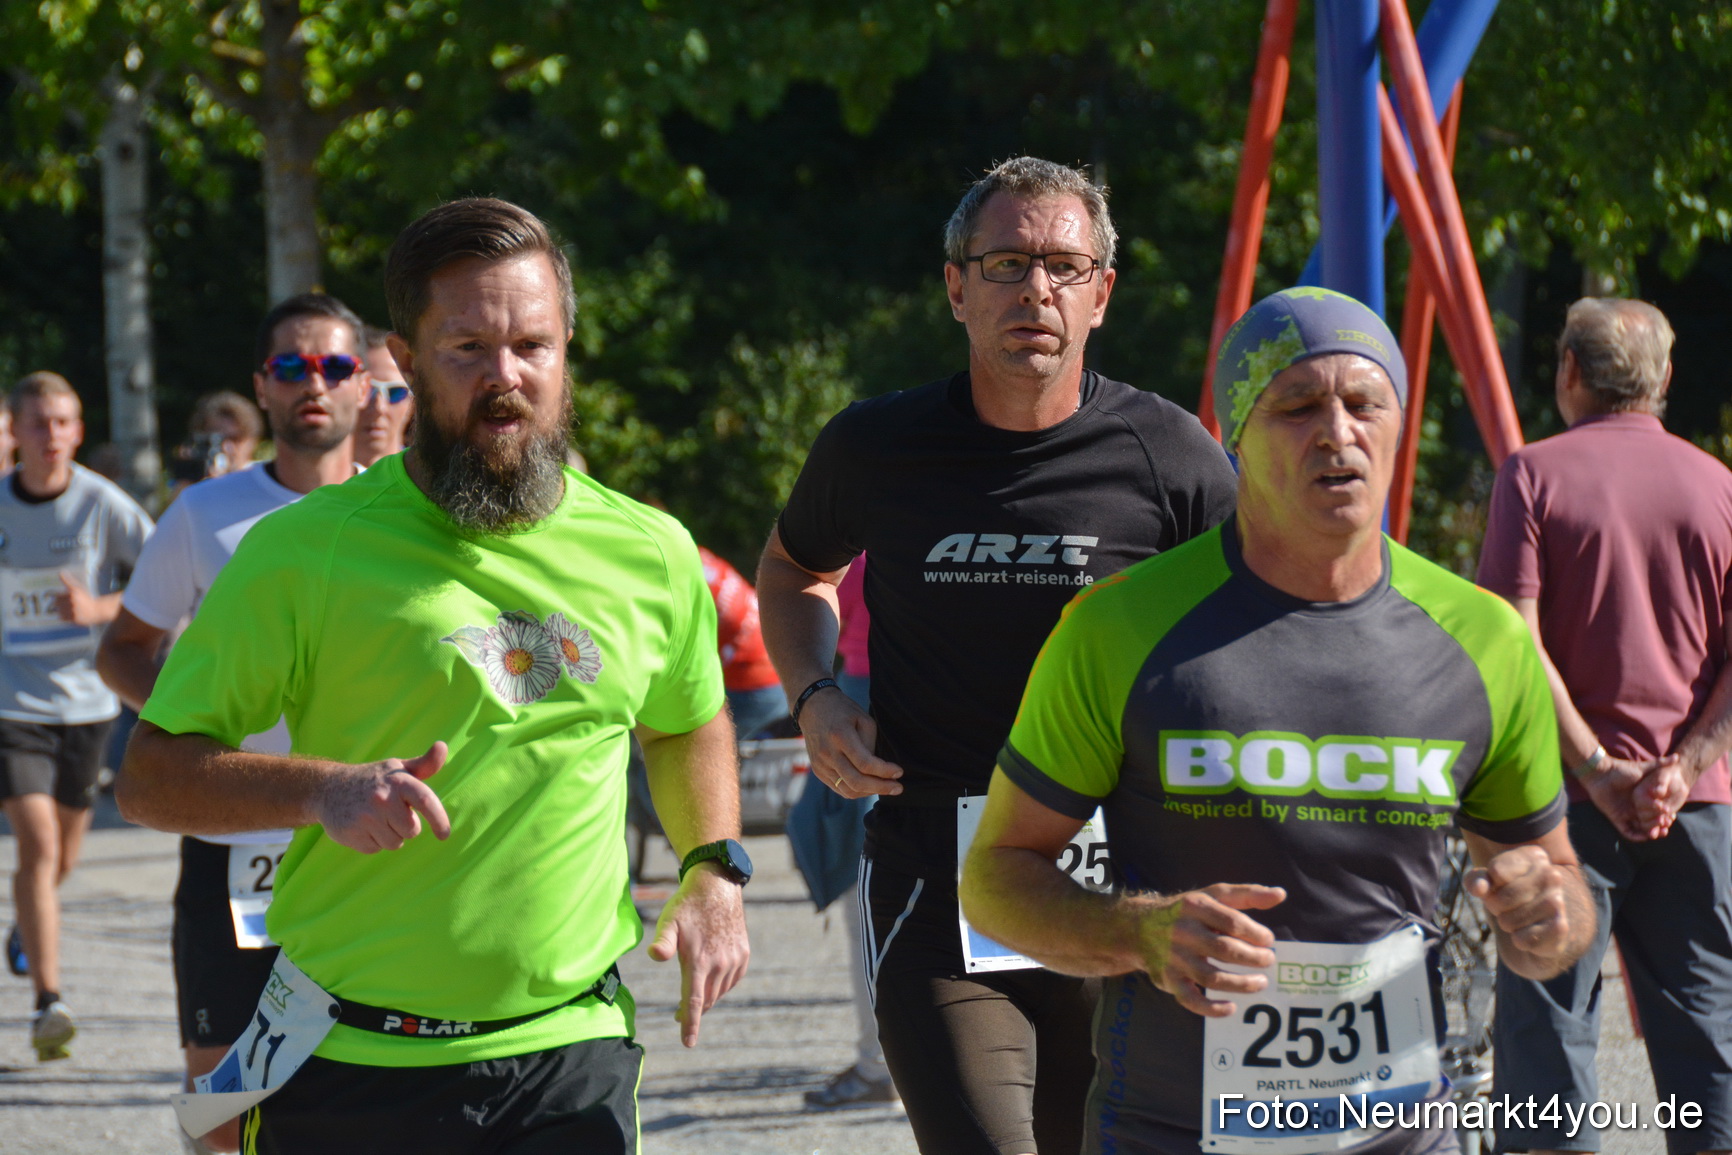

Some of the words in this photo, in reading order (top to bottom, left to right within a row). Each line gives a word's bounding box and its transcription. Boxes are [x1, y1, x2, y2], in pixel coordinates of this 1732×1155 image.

[925, 533, 1099, 566] ARZT
[924, 570, 1094, 586] www.arzt-reisen.de
[12, 589, 58, 617] 312
[1161, 732, 1462, 803] BOCK
[1163, 796, 1253, 819] inspired
[1261, 798, 1289, 824] by
[1296, 805, 1368, 823] smart
[249, 852, 286, 893] 2
[1059, 842, 1113, 891] 25
[265, 968, 295, 1010] CK
[1278, 962, 1370, 986] BOCK
[1242, 990, 1390, 1068] 2531
[1218, 1054, 1227, 1066] A
[1256, 1079, 1304, 1091] PARTL
[1309, 1071, 1371, 1089] Neumarkt
